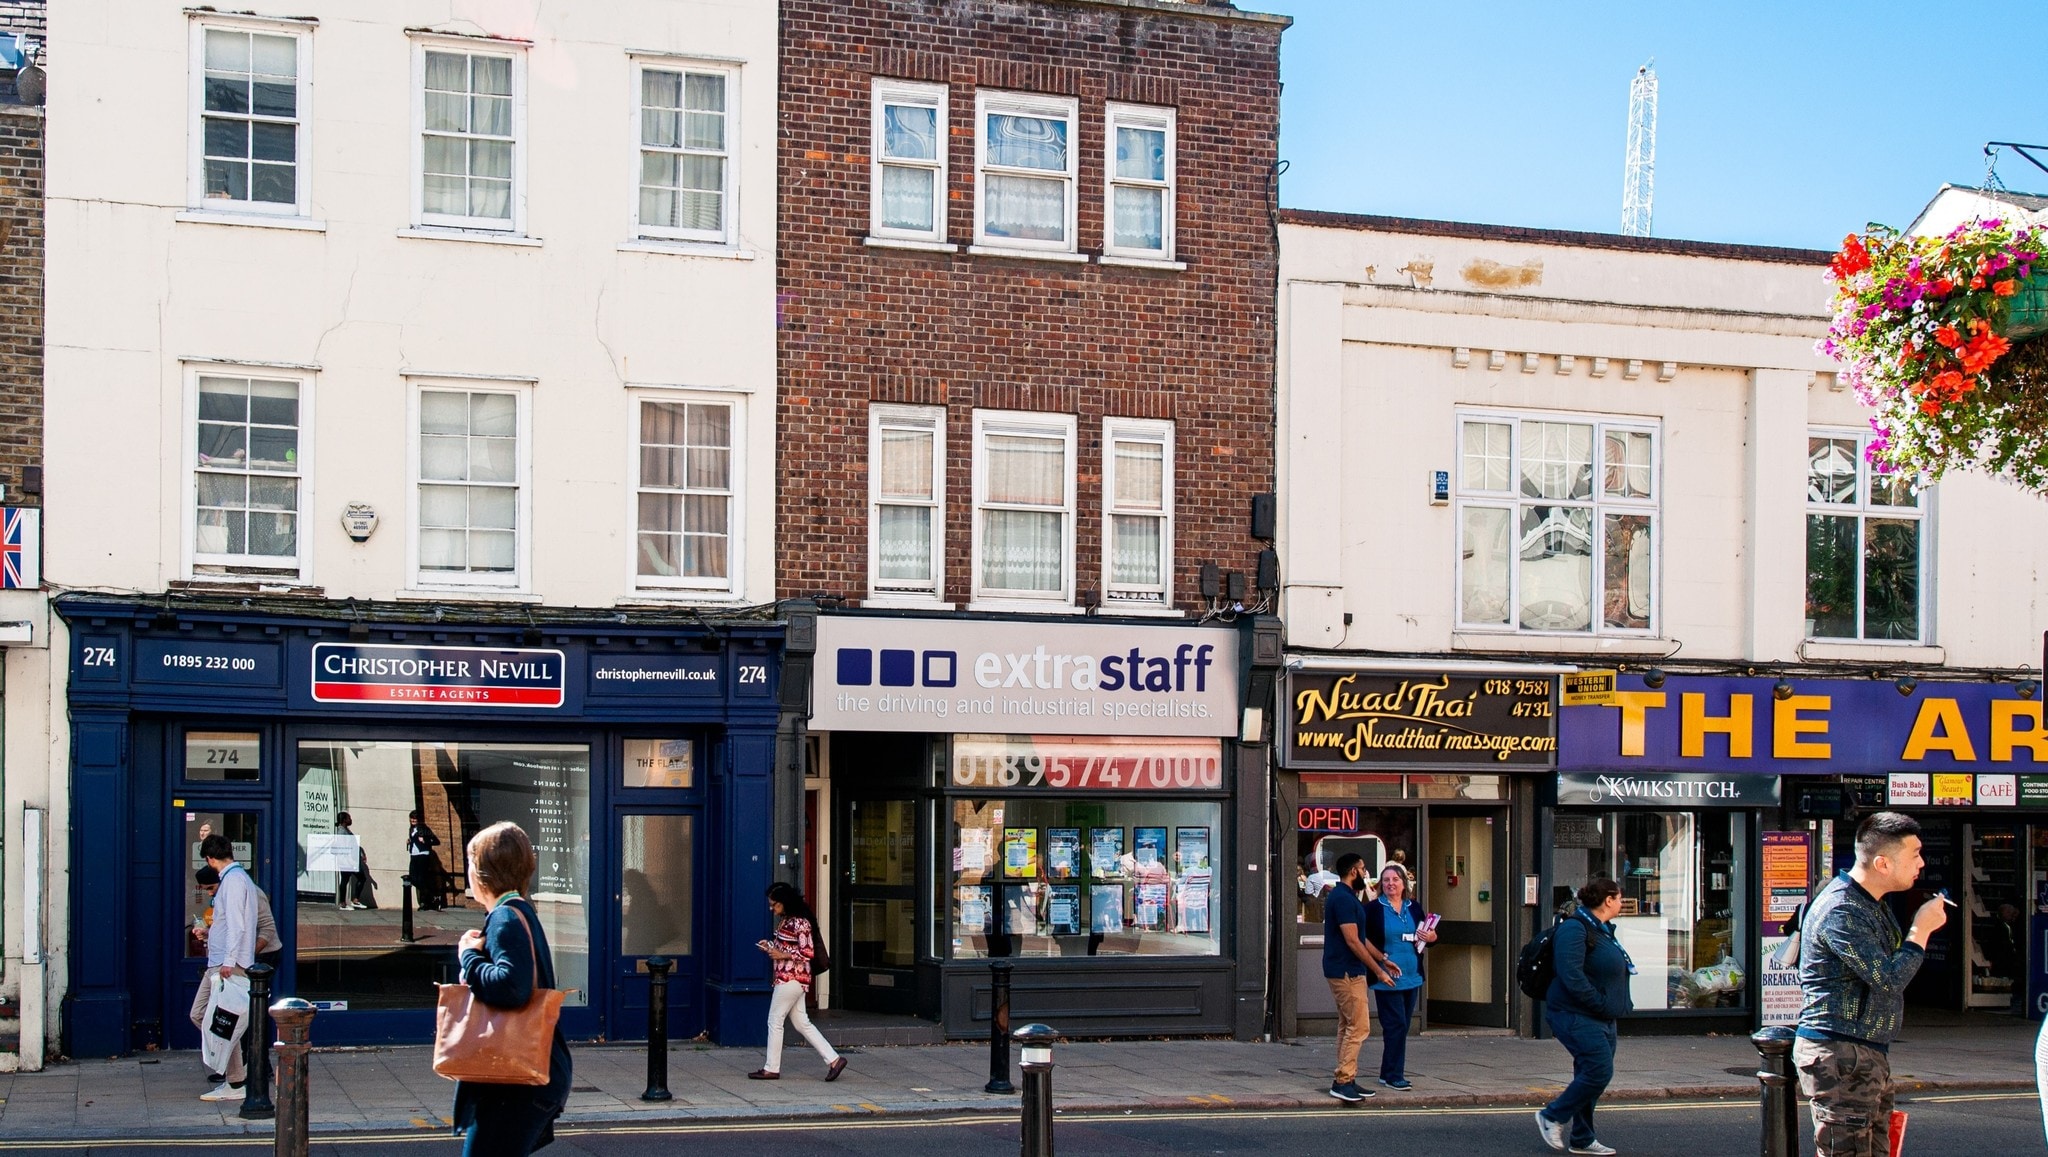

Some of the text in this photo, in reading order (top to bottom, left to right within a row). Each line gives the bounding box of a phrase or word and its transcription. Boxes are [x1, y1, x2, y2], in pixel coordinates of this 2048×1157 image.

[83, 647, 116, 666] 274
[163, 654, 256, 670] 01895 232 000
[324, 654, 553, 680] CHRISTOPHER NEVILL
[595, 667, 716, 682] christophernevill.co.uk
[738, 666, 767, 683] 274
[973, 643, 1214, 693] extrastaff
[1484, 679, 1550, 696] 018 9581
[1567, 676, 1605, 686] WESTERN
[1577, 684, 1605, 692] UNION
[390, 688, 489, 700] ESTATE AGENTS
[1297, 672, 1477, 725] Nuad Thai
[837, 693, 1214, 721] the driving and industrial specialists.
[1602, 691, 1832, 759] THE
[206, 749, 239, 765] 274
[636, 758, 681, 768] THE FLAT
[1909, 781, 1926, 790] Baby
[1939, 775, 1964, 785] Glamour
[1890, 789, 1927, 797] Hair Studio
[1941, 784, 1964, 794] Beauty
[1298, 807, 1356, 830] OPEN
